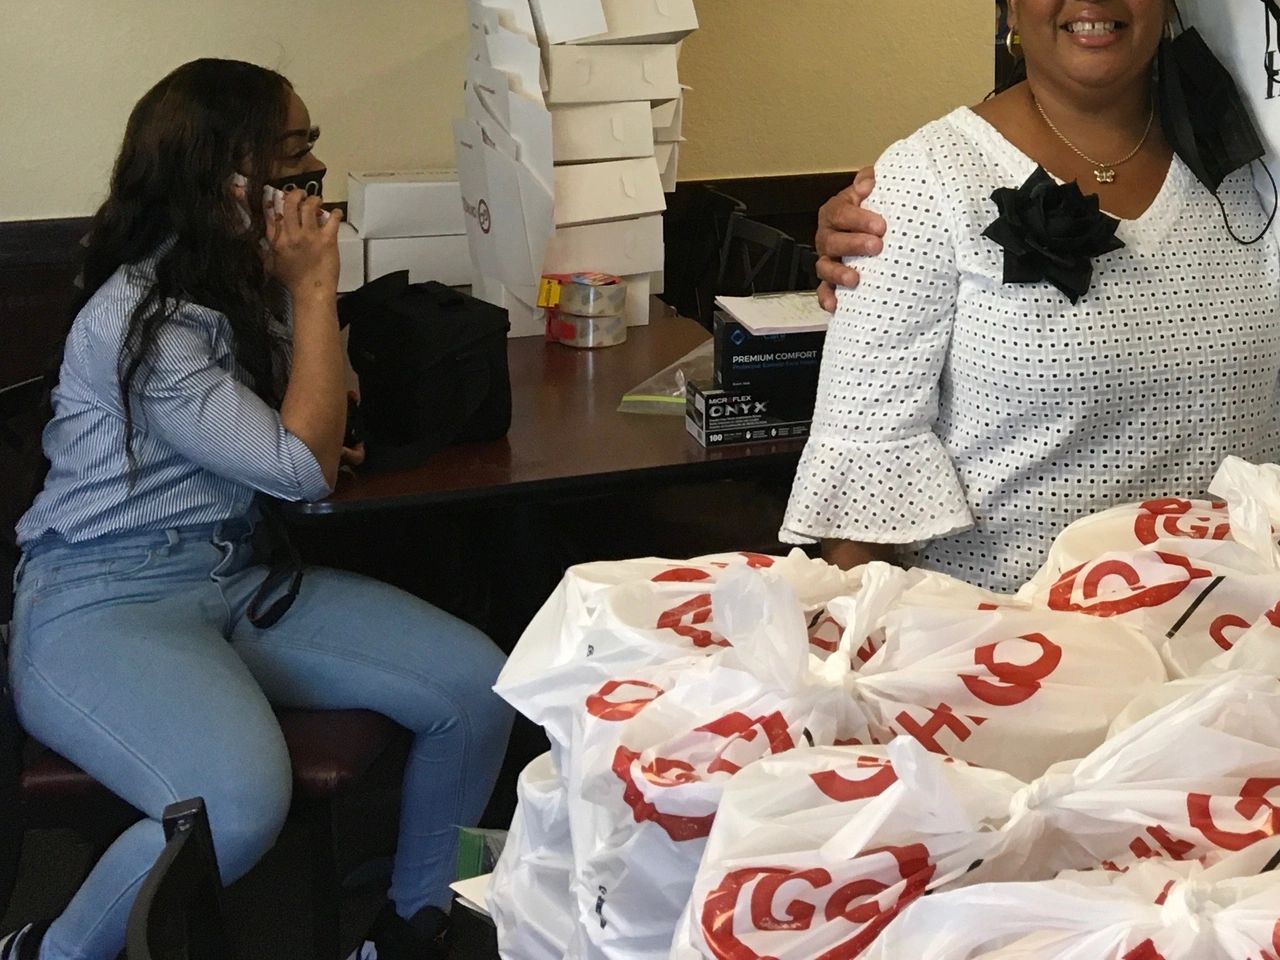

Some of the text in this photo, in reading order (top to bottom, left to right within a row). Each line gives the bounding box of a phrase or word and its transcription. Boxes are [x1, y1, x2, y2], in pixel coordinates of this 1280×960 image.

[732, 351, 818, 363] PREMIUM COMFORT
[709, 401, 768, 418] ONYX
